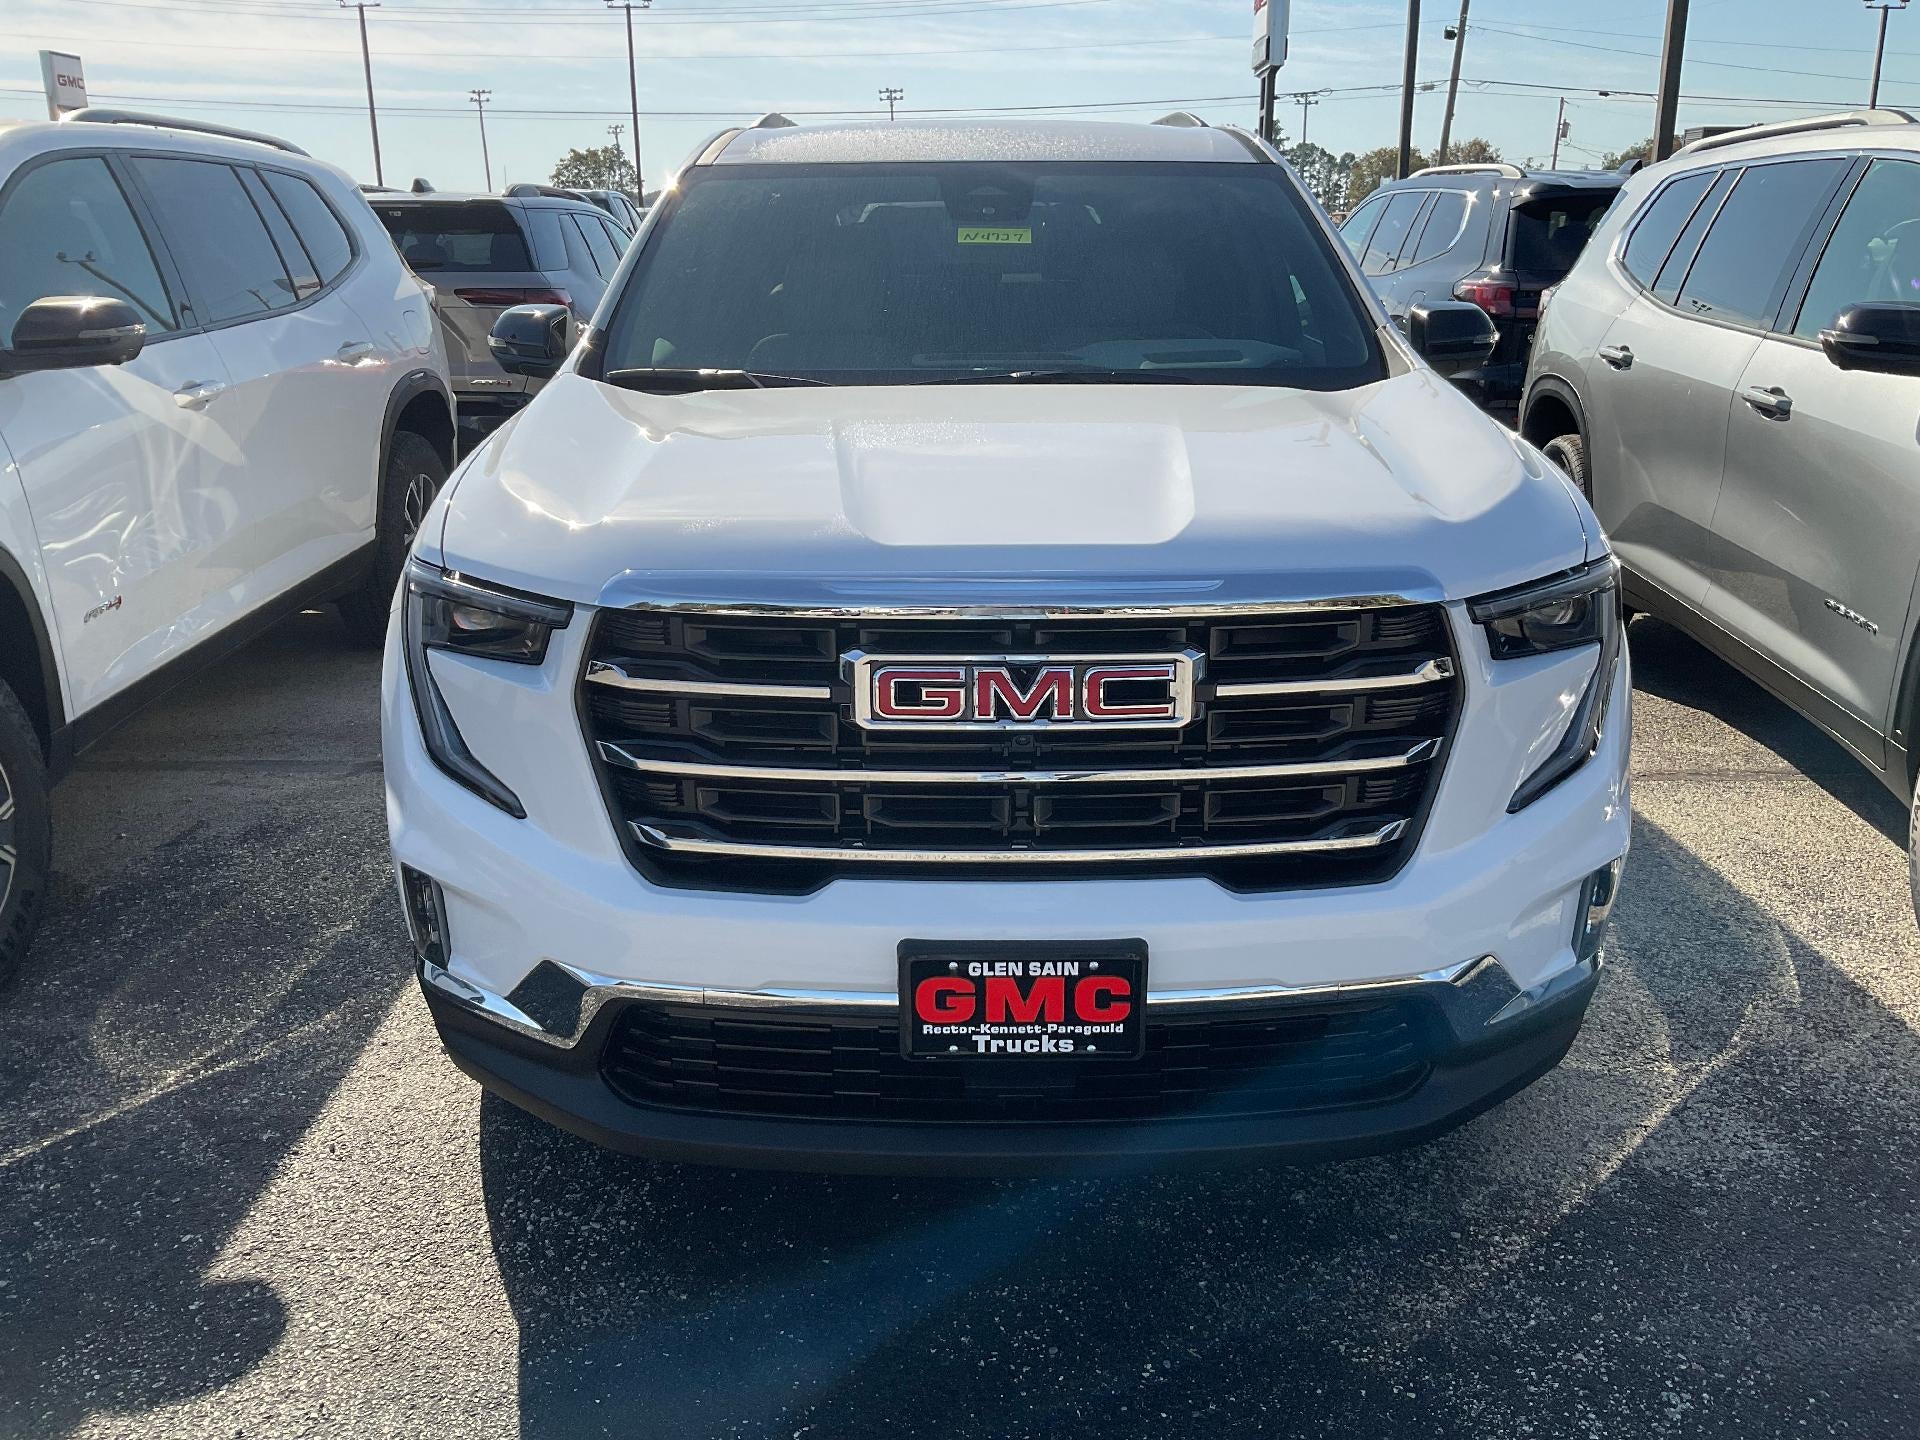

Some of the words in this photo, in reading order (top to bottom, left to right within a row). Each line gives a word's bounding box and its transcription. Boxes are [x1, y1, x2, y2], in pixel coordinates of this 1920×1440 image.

[57, 73, 85, 90] GMC
[873, 664, 1176, 722] GMC
[968, 961, 1023, 976] GLEN
[1029, 961, 1079, 976] SAIN
[915, 975, 1131, 1024] GMC
[972, 1034, 1075, 1053] Trucks
